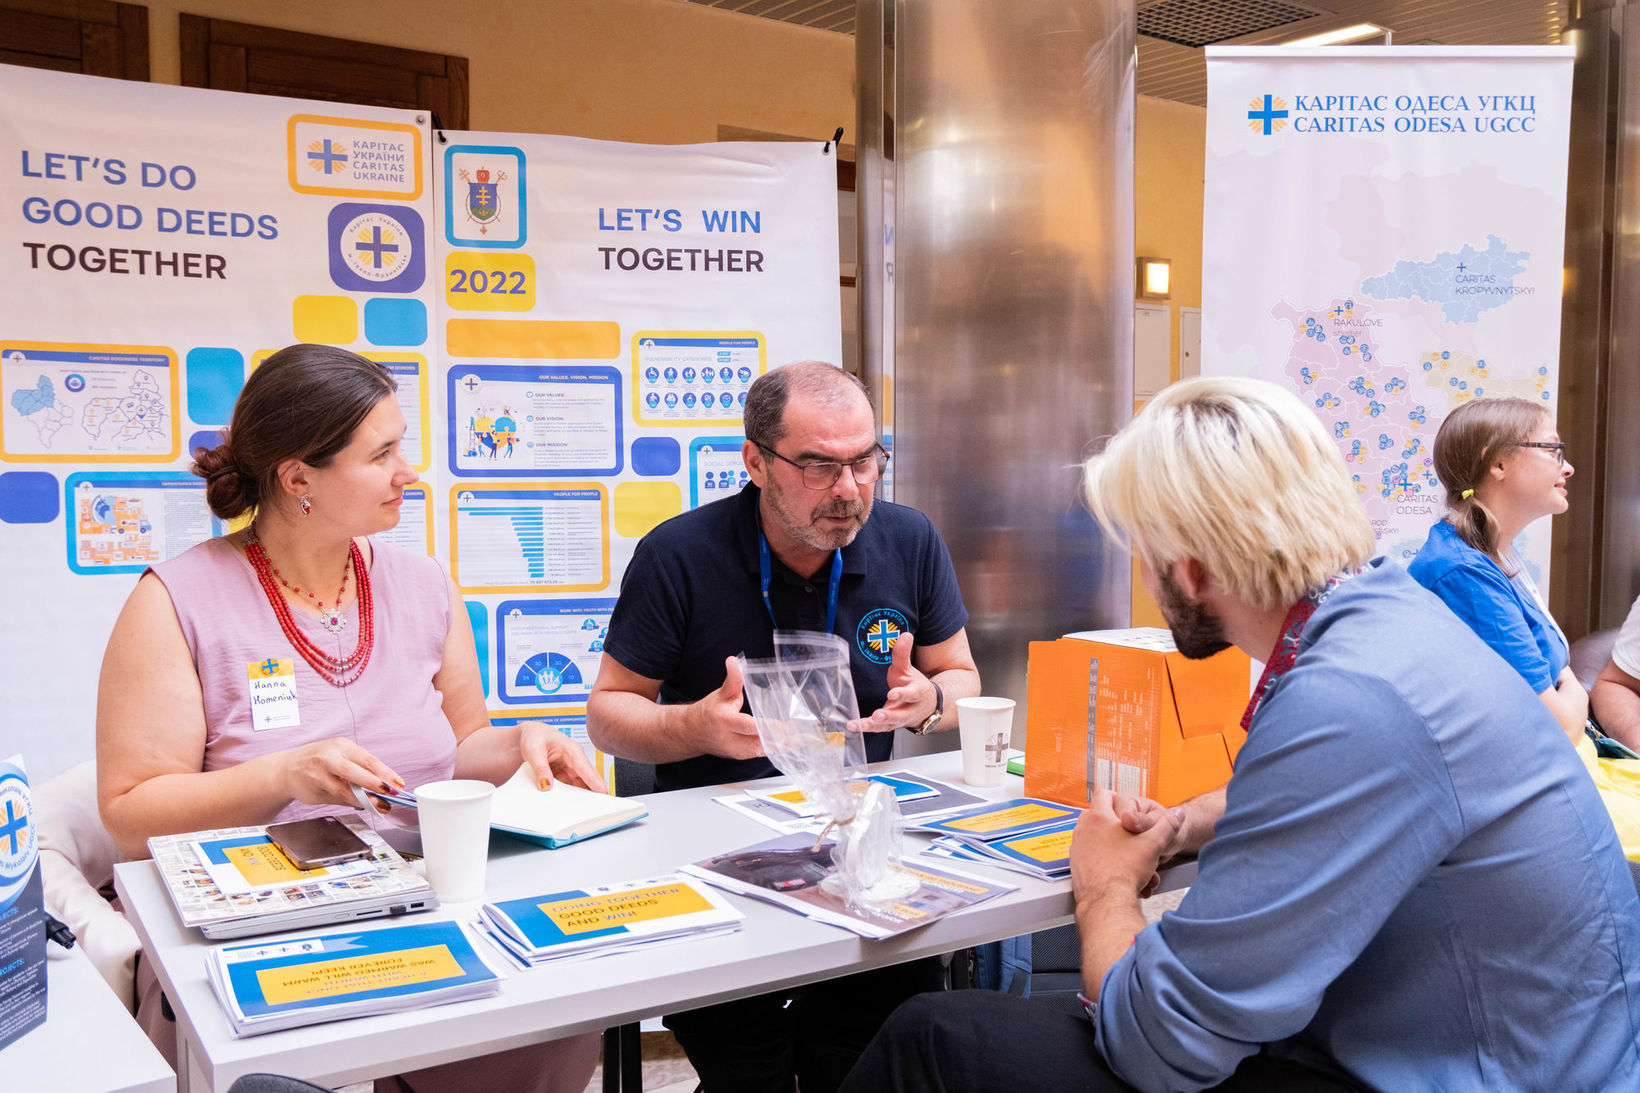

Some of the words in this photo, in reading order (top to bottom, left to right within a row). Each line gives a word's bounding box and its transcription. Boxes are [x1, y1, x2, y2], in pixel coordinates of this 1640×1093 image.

[1294, 95, 1388, 111] КАРІТАС
[1395, 95, 1470, 115] ОДЕСА
[1477, 95, 1536, 114] УГКЦ
[1294, 116, 1385, 133] CARITAS
[1394, 116, 1467, 133] ODESA
[1474, 116, 1536, 133] UGCC
[353, 140, 405, 152] КАРІТАС
[353, 150, 405, 162] УКРАЇНИ
[21, 150, 127, 185] LET'S
[141, 162, 197, 191] DO
[353, 161, 405, 172] CARITAS
[353, 171, 405, 183] UKRAINE
[22, 197, 143, 230] GOOD
[157, 207, 279, 240] DEEDS
[598, 208, 682, 232] LET'S
[701, 210, 761, 234] WIN
[22, 242, 228, 280] TOGETHER
[598, 247, 764, 273] TOGETHER
[450, 269, 526, 295] 2022
[1455, 275, 1497, 283] CARITAS
[1455, 286, 1535, 296] KROPYVNYTSKYI
[1333, 318, 1384, 327] RAKULOVE
[1396, 495, 1439, 504] CARITAS
[1396, 506, 1433, 515] ODESA
[254, 681, 286, 690] Hanna
[559, 906, 605, 919] GOOD
[608, 899, 658, 912] DEEDS
[567, 916, 600, 927] AND
